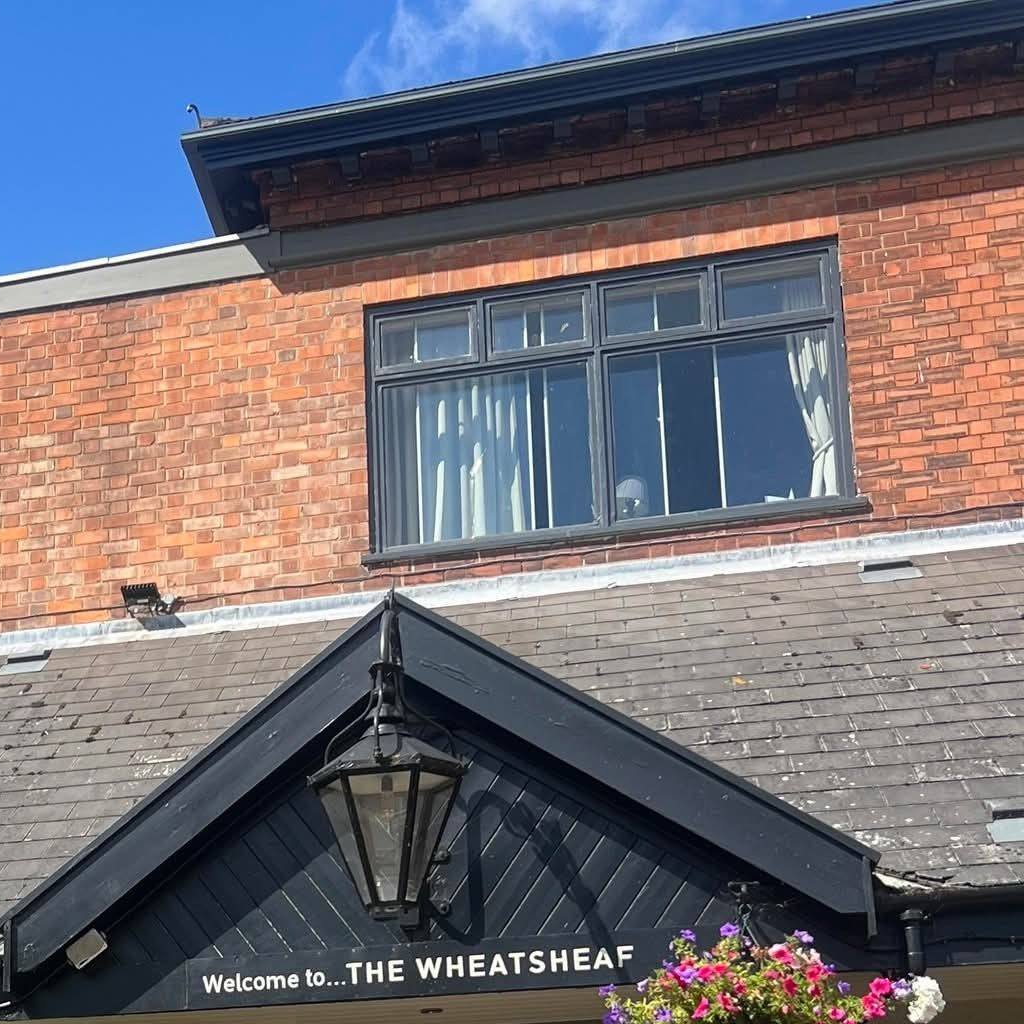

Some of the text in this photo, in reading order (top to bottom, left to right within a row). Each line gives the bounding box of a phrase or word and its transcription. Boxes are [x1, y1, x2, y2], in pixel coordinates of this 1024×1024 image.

[202, 974, 299, 994] Welcome
[346, 959, 404, 985] THE
[415, 945, 634, 980] WHEATSHEAF
